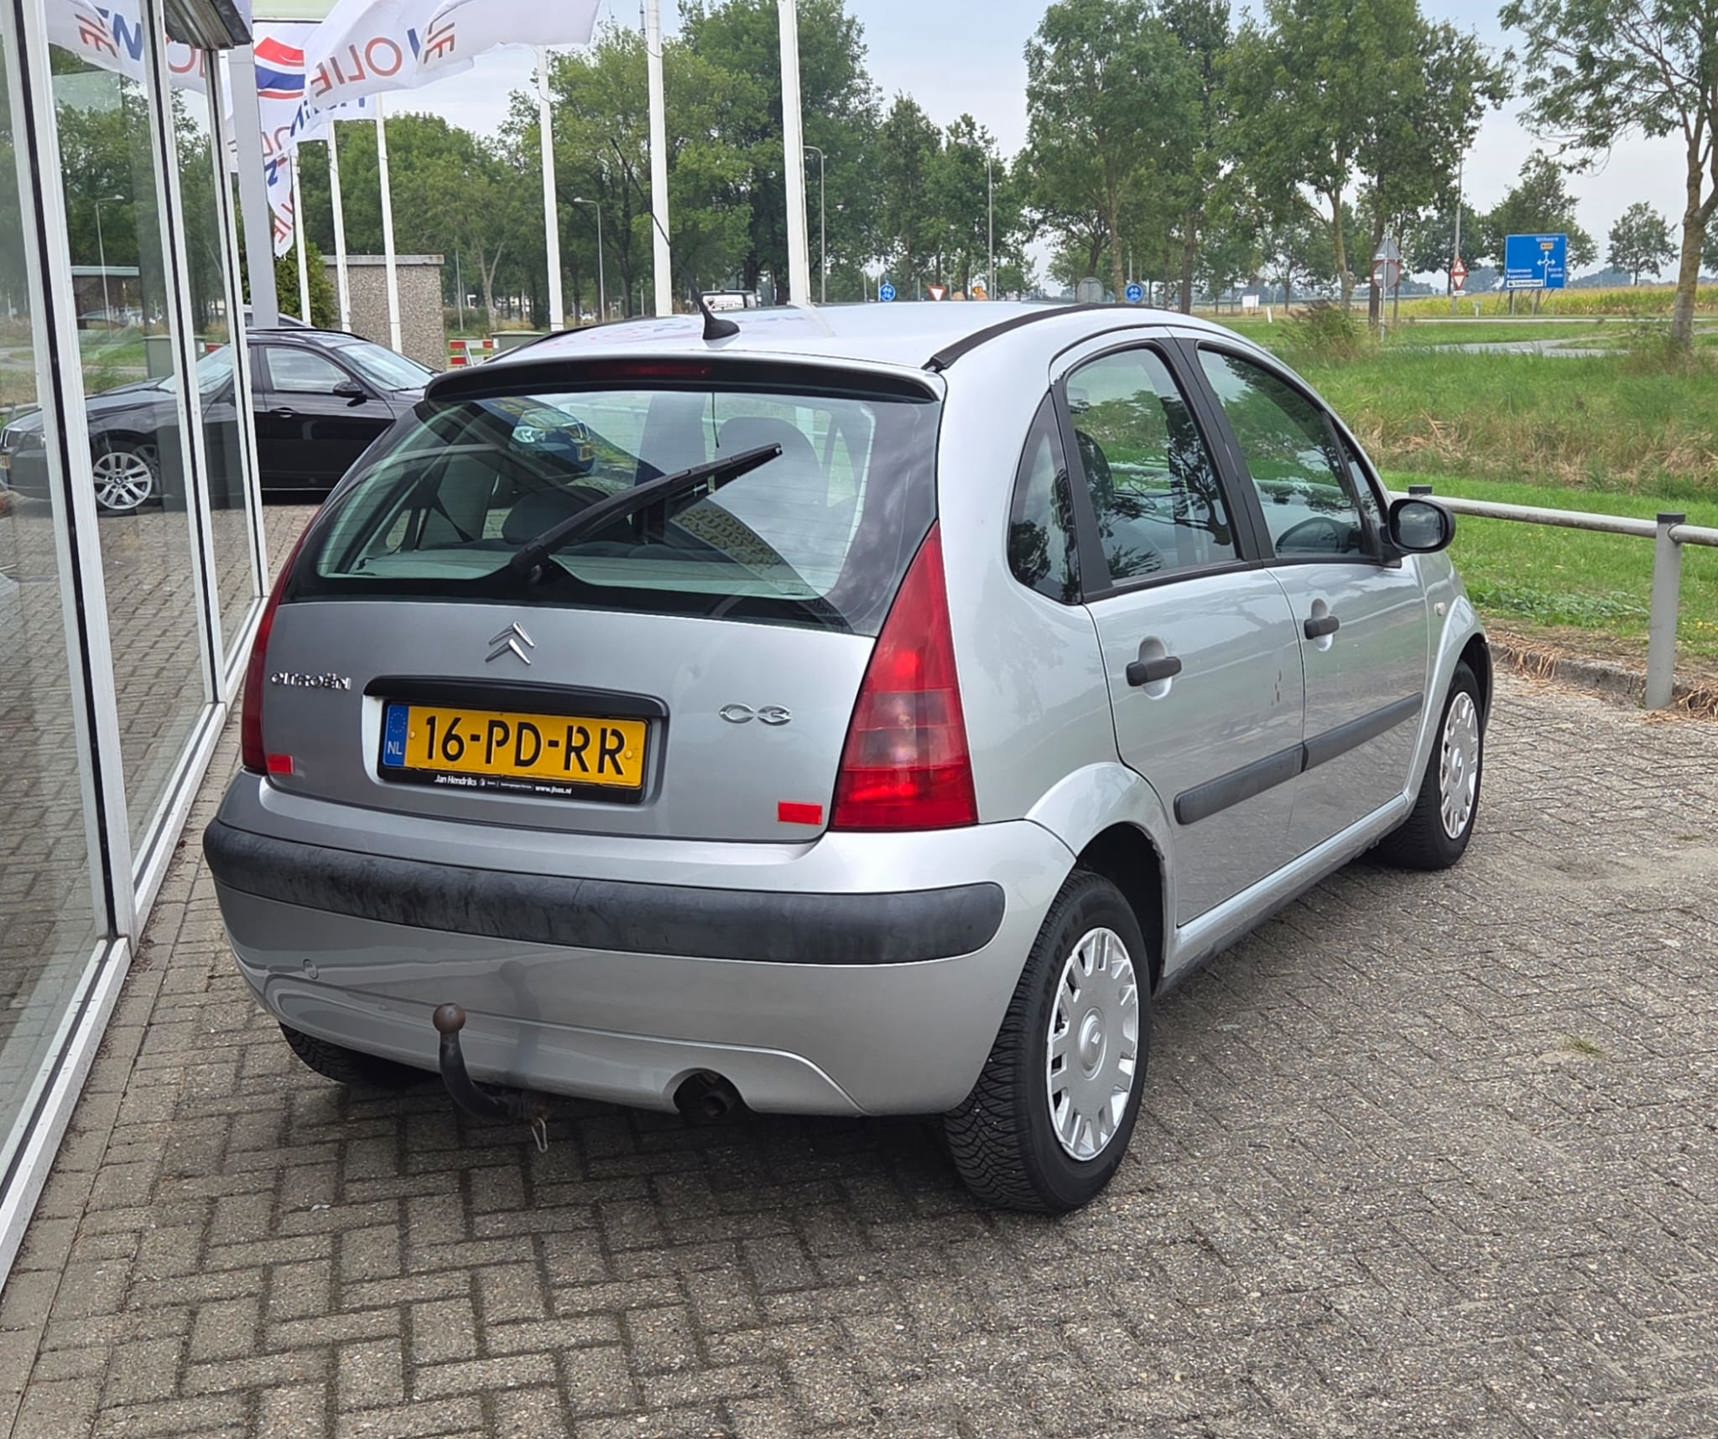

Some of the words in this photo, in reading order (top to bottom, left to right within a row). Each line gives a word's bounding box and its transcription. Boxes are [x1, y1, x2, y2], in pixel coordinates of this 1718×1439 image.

[720, 703, 792, 726] C3
[387, 740, 403, 756] NL
[425, 714, 626, 776] 16-PD-RR
[434, 774, 447, 784] Jan
[447, 774, 477, 787] Hendriks
